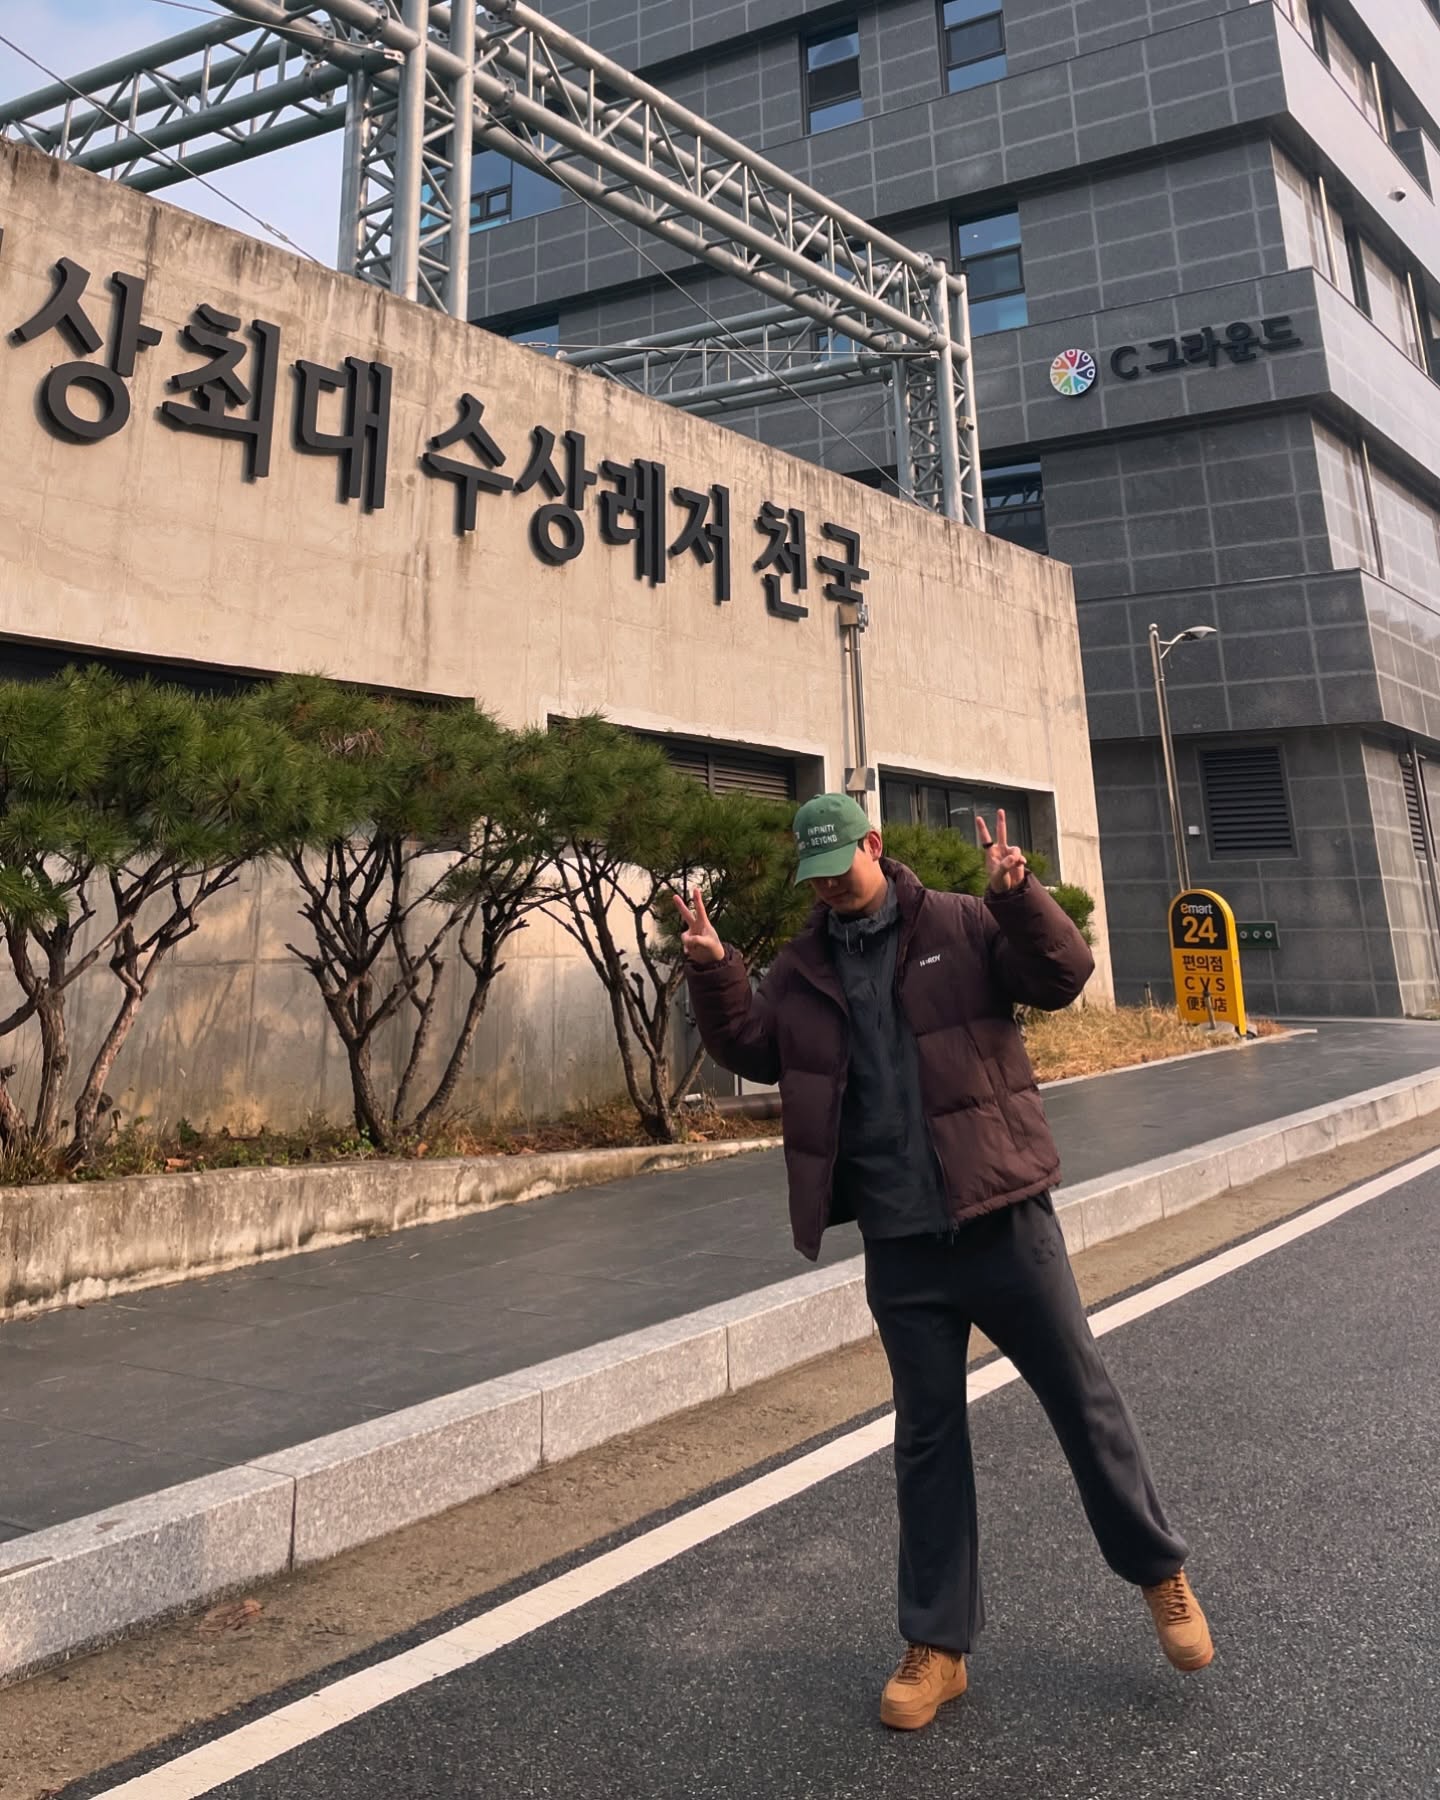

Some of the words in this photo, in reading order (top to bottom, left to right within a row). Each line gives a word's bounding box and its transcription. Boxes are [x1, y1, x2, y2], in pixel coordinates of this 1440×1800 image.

[0, 228, 393, 510] 상최대
[421, 392, 731, 602] 수상레저
[754, 501, 870, 619] 천국
[807, 824, 834, 836] INFINITY
[1180, 903, 1213, 915] emart
[1182, 916, 1218, 944] 24
[1182, 954, 1223, 972] 편의점
